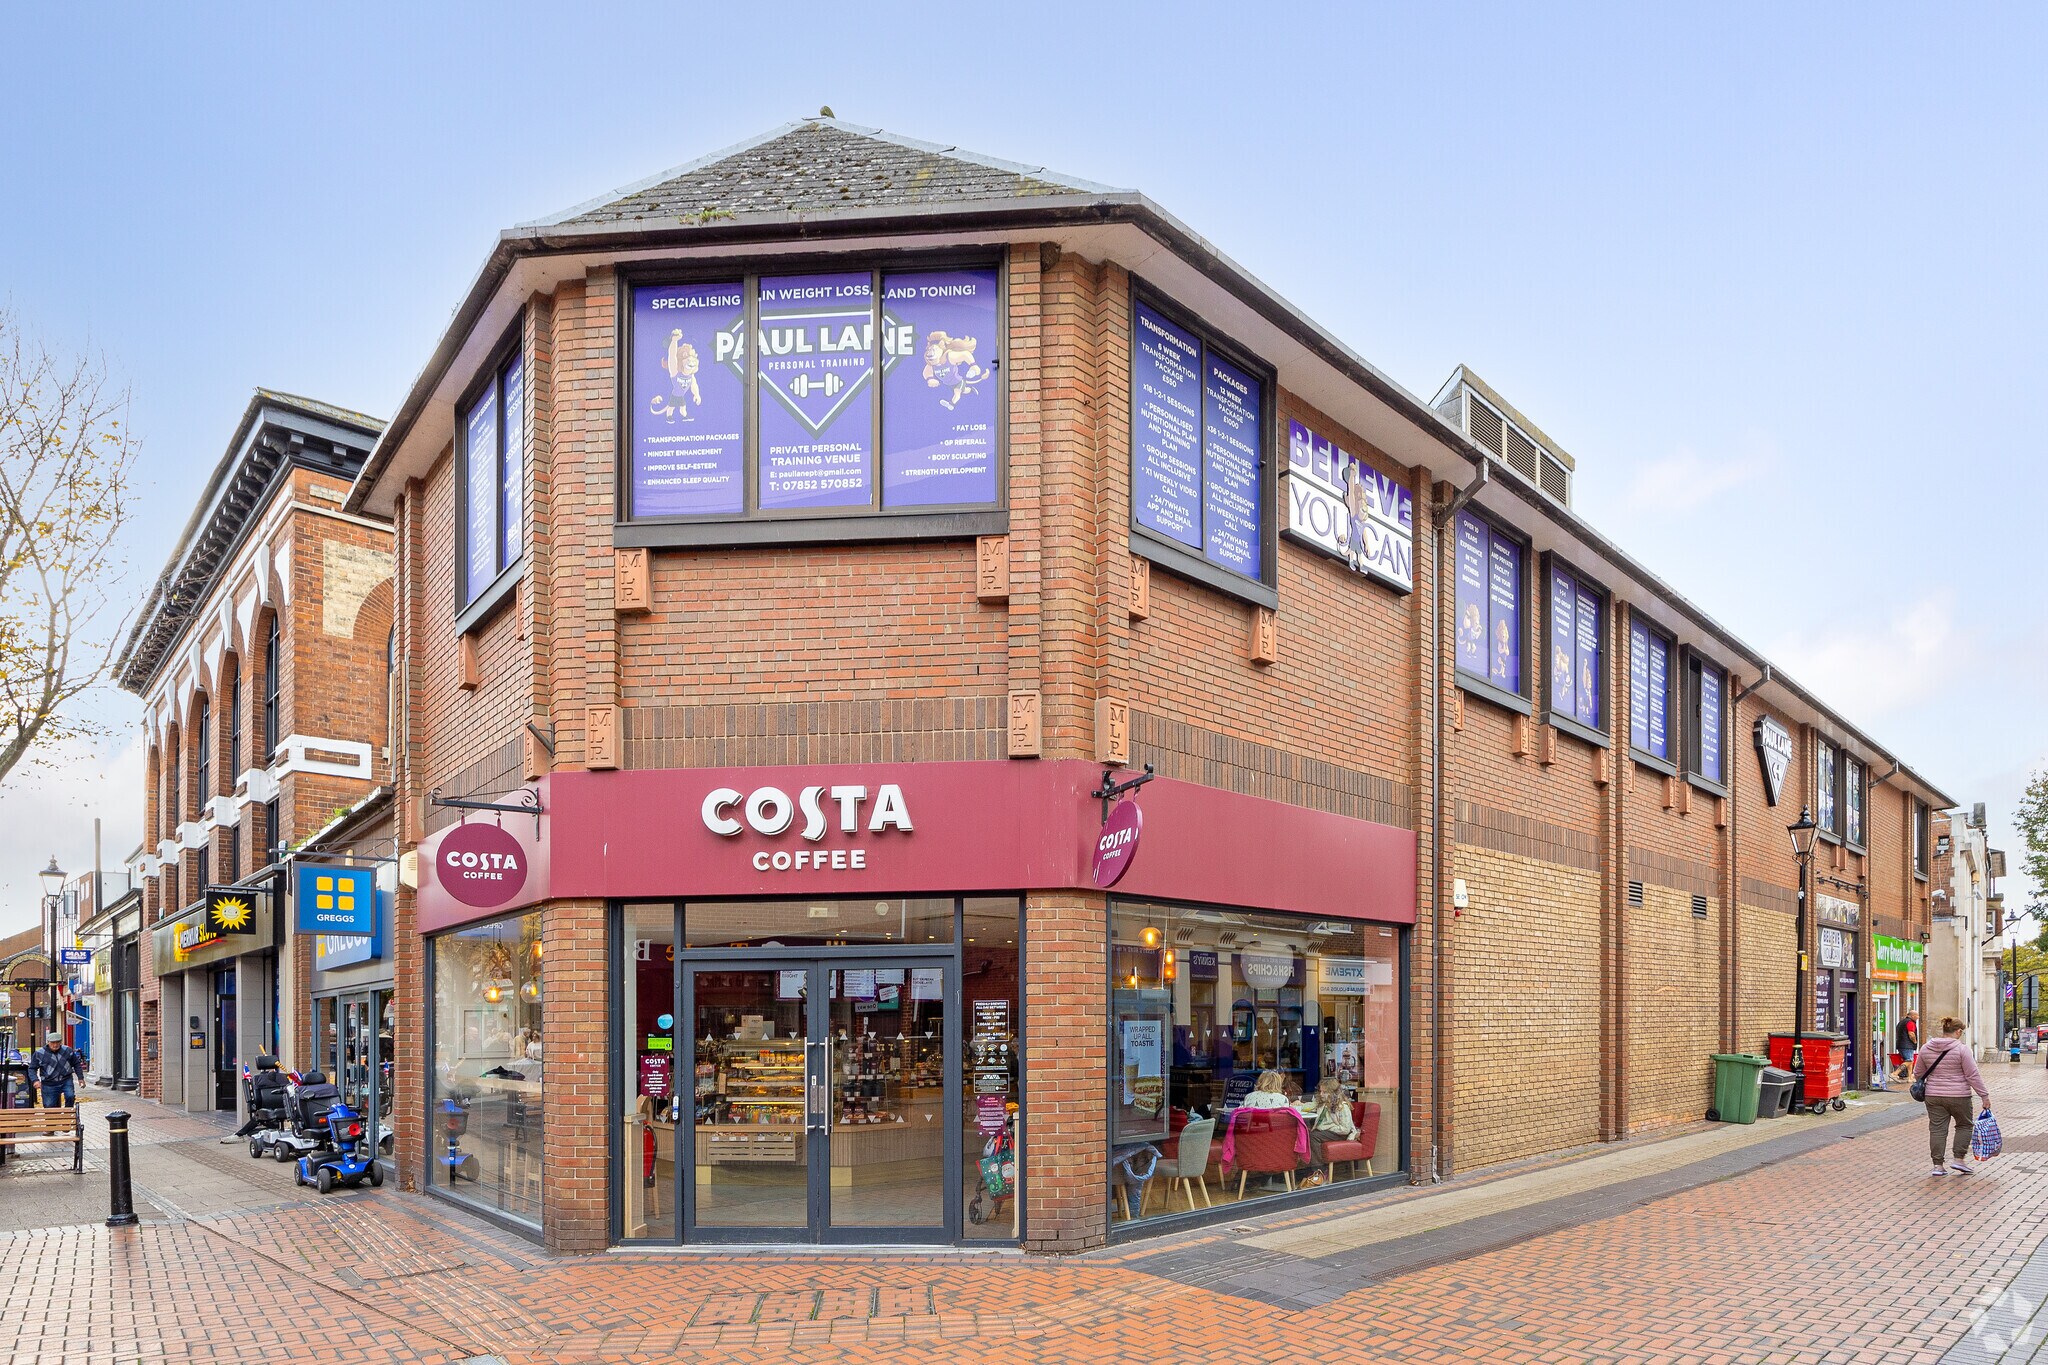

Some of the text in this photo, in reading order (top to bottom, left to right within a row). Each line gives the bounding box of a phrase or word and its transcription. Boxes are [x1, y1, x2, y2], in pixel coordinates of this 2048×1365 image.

[651, 295, 741, 310] SPECIALISING
[779, 287, 832, 300] WEIGHT
[920, 285, 976, 297] TONING!
[1140, 316, 1196, 357] TRANSFORMATION
[1141, 342, 1196, 380] TRANSFORMATION
[1163, 345, 1181, 362] WEEK
[769, 358, 865, 370] PERSONAL TRAINING
[1155, 361, 1183, 382] PACKAGE
[1213, 368, 1248, 395] PACKAGES
[1167, 396, 1195, 417] SESSIONS
[1206, 387, 1255, 421] TRANSFORMATION
[1226, 389, 1242, 405] WEEK
[1150, 403, 1193, 432] PERSONALISED
[1218, 404, 1243, 424] PACKAGE
[970, 423, 986, 431] LOSS
[1141, 408, 1197, 444] NUTRITIONAL PLAN
[1148, 423, 1190, 449] AND TRAINING
[648, 433, 739, 443] TRANSFORMATION PACKAGES
[1162, 439, 1177, 452] PLAN
[1229, 435, 1254, 456] SESSIONS
[676, 448, 722, 456] ENHANCEMENT
[770, 443, 861, 454] PRIVATE PERSONAL
[932, 452, 986, 461] BODY SCULPTING
[1213, 443, 1252, 469] PERSONALISED
[676, 462, 717, 470] SELF-ESTEEM
[771, 454, 860, 466] TRAINING VENUE
[1146, 444, 1196, 475] GROUP SESSIONS
[1148, 455, 1191, 482] ALL INCLUSIVE
[1206, 448, 1256, 481] NUTRITIONAL PLAN
[940, 466, 986, 475] DEVELOPMENT
[1212, 461, 1250, 486] AND TRAINING
[769, 478, 862, 491] T: 07852 570852
[1153, 470, 1178, 488] WEEKLY
[1180, 482, 1197, 497] VIDEO
[1162, 485, 1177, 498] CALL
[1223, 476, 1239, 489] PLAN
[1210, 482, 1255, 510] GROUP SESSIONS
[1212, 492, 1250, 516] ALL INCLUSIVE
[1147, 502, 1192, 528] APP AND EMAIL
[1156, 515, 1183, 533] SUPPORT
[1217, 506, 1239, 523] WEEKLY
[1239, 517, 1256, 531] VIDEO
[1224, 520, 1238, 532] CALL
[1291, 482, 1412, 581] YOU CAN
[1211, 535, 1251, 559] APP AND EMAIL
[1465, 531, 1478, 544] YEARS
[1219, 547, 1243, 564] SUPPORT
[1460, 539, 1483, 558] EXPERIENCE
[1463, 563, 1479, 577] FITNESS
[1462, 574, 1480, 589] INDUSTRY
[701, 783, 914, 842] COSTA
[1099, 827, 1132, 851] COSTA
[446, 851, 518, 870] COSTA
[752, 849, 867, 872] COFFEE
[1103, 848, 1121, 860] COFFEE
[463, 871, 503, 880] COFFEE
[316, 914, 355, 923] GREGGS
